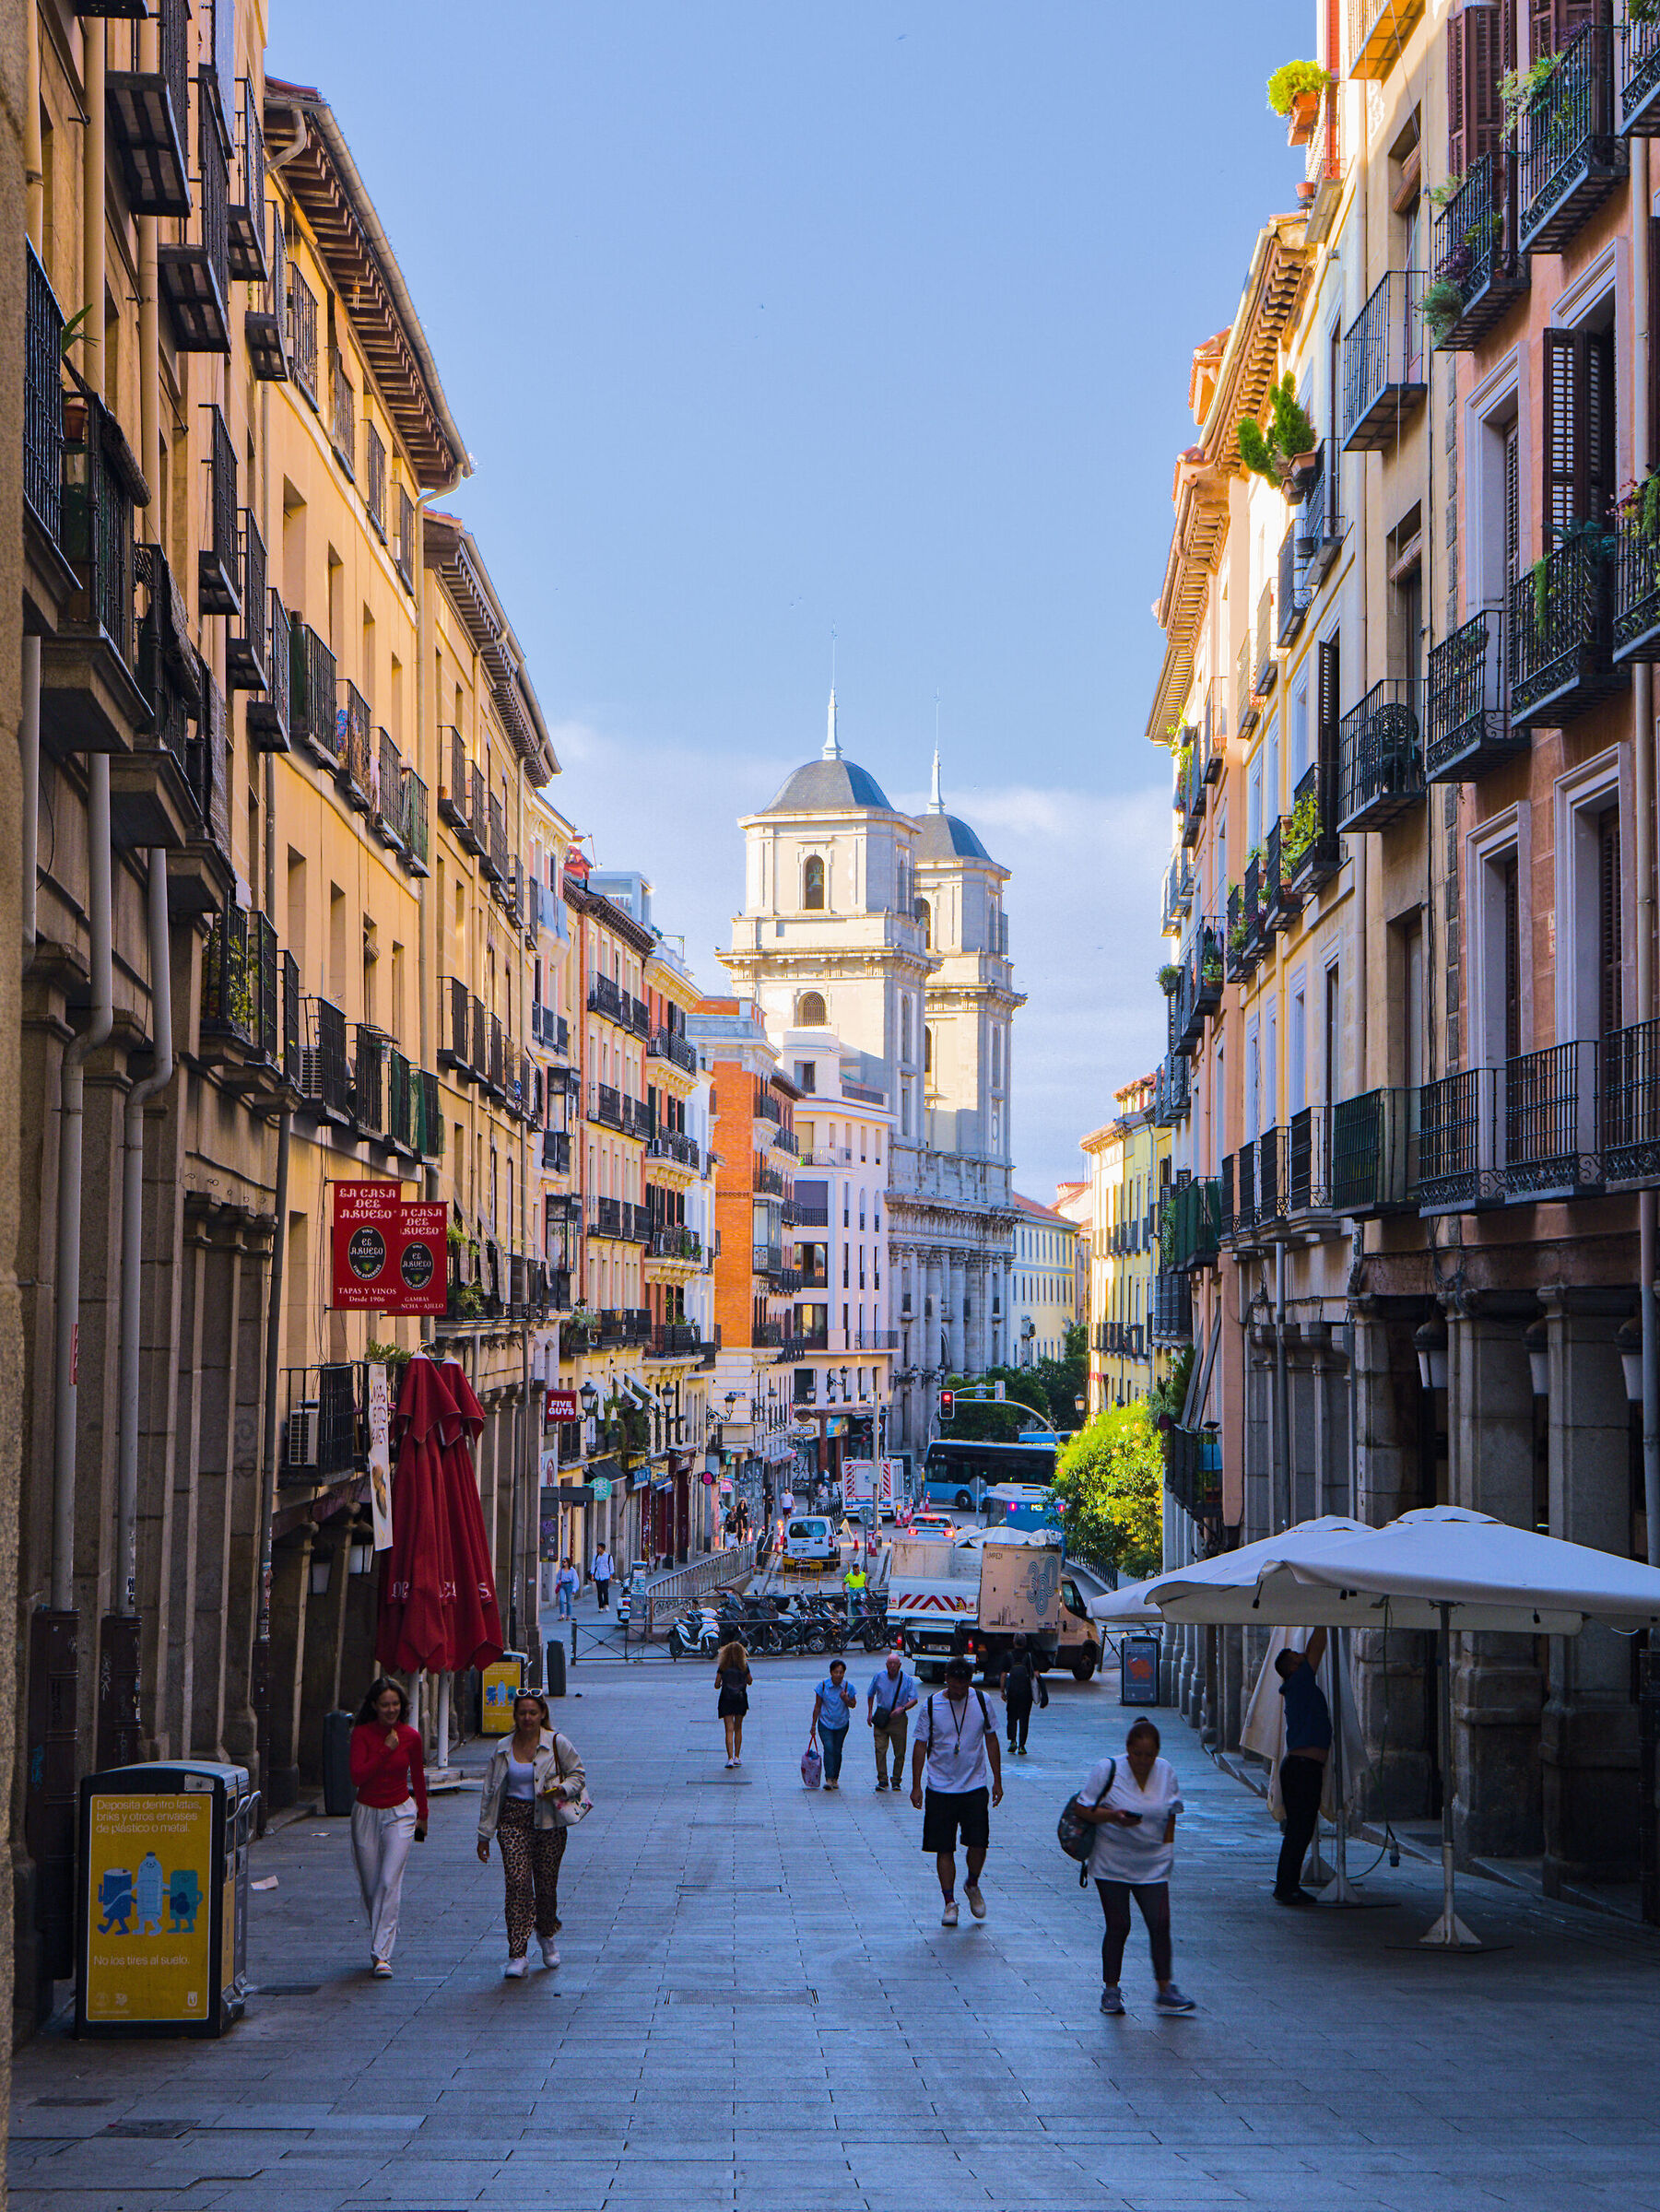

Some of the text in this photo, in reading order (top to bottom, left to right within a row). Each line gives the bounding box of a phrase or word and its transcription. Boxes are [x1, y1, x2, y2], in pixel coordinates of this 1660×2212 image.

[339, 1188, 395, 1198] LA CASA
[355, 1199, 381, 1208] DEL
[340, 1209, 392, 1218] ABUELO
[400, 1208, 442, 1217] A CASA
[406, 1218, 430, 1226] DEL
[400, 1227, 440, 1235] BUELO
[361, 1238, 371, 1246] EL
[350, 1247, 383, 1255] ABUELO
[402, 1260, 432, 1268] ABUELO
[548, 1407, 574, 1416] GUYS
[96, 1799, 202, 1812] Deposita dentro latas,
[96, 1811, 198, 1824] briks y otros envases
[95, 1822, 190, 1835] de plástico o metal.
[93, 1954, 191, 1966] No los tires al suelo.
